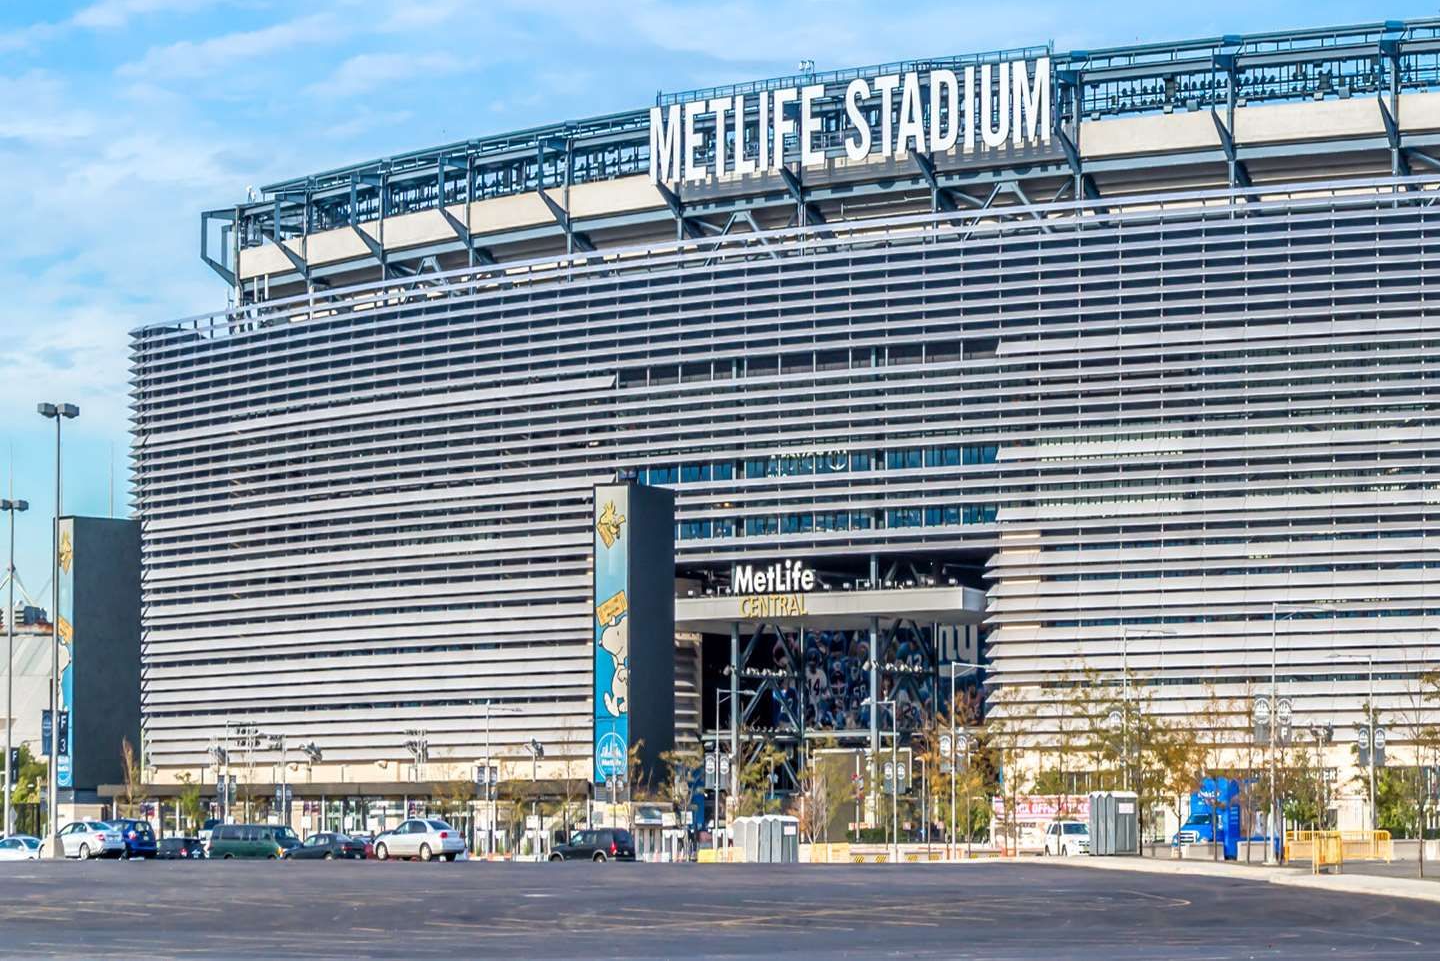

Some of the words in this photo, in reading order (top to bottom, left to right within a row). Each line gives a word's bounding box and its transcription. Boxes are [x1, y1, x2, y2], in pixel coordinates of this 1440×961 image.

[649, 86, 825, 186] METLIFE
[844, 57, 1051, 161] STADIUM
[734, 559, 815, 594] MetLife
[739, 593, 808, 618] CENTRAL
